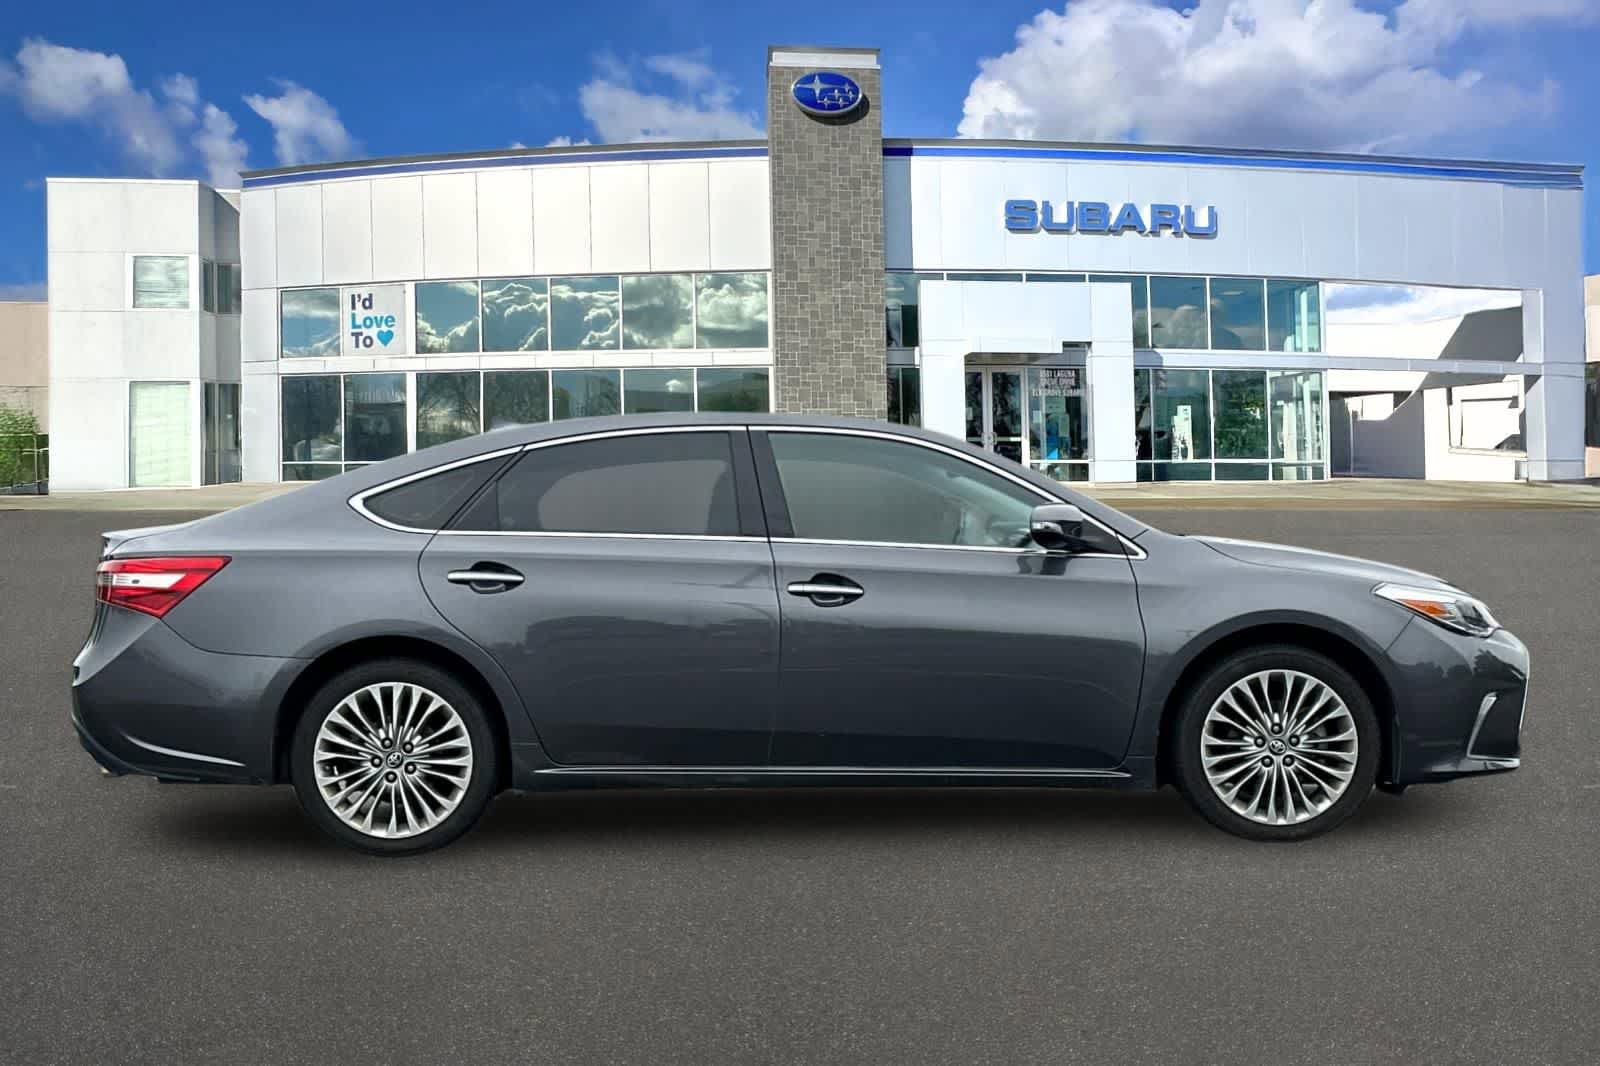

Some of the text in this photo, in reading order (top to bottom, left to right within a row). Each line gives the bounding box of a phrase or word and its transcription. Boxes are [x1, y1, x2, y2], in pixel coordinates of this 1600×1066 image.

[1005, 200, 1216, 237] SUBARU
[351, 293, 373, 310] I'd
[351, 312, 396, 329] Love
[351, 331, 374, 348] To
